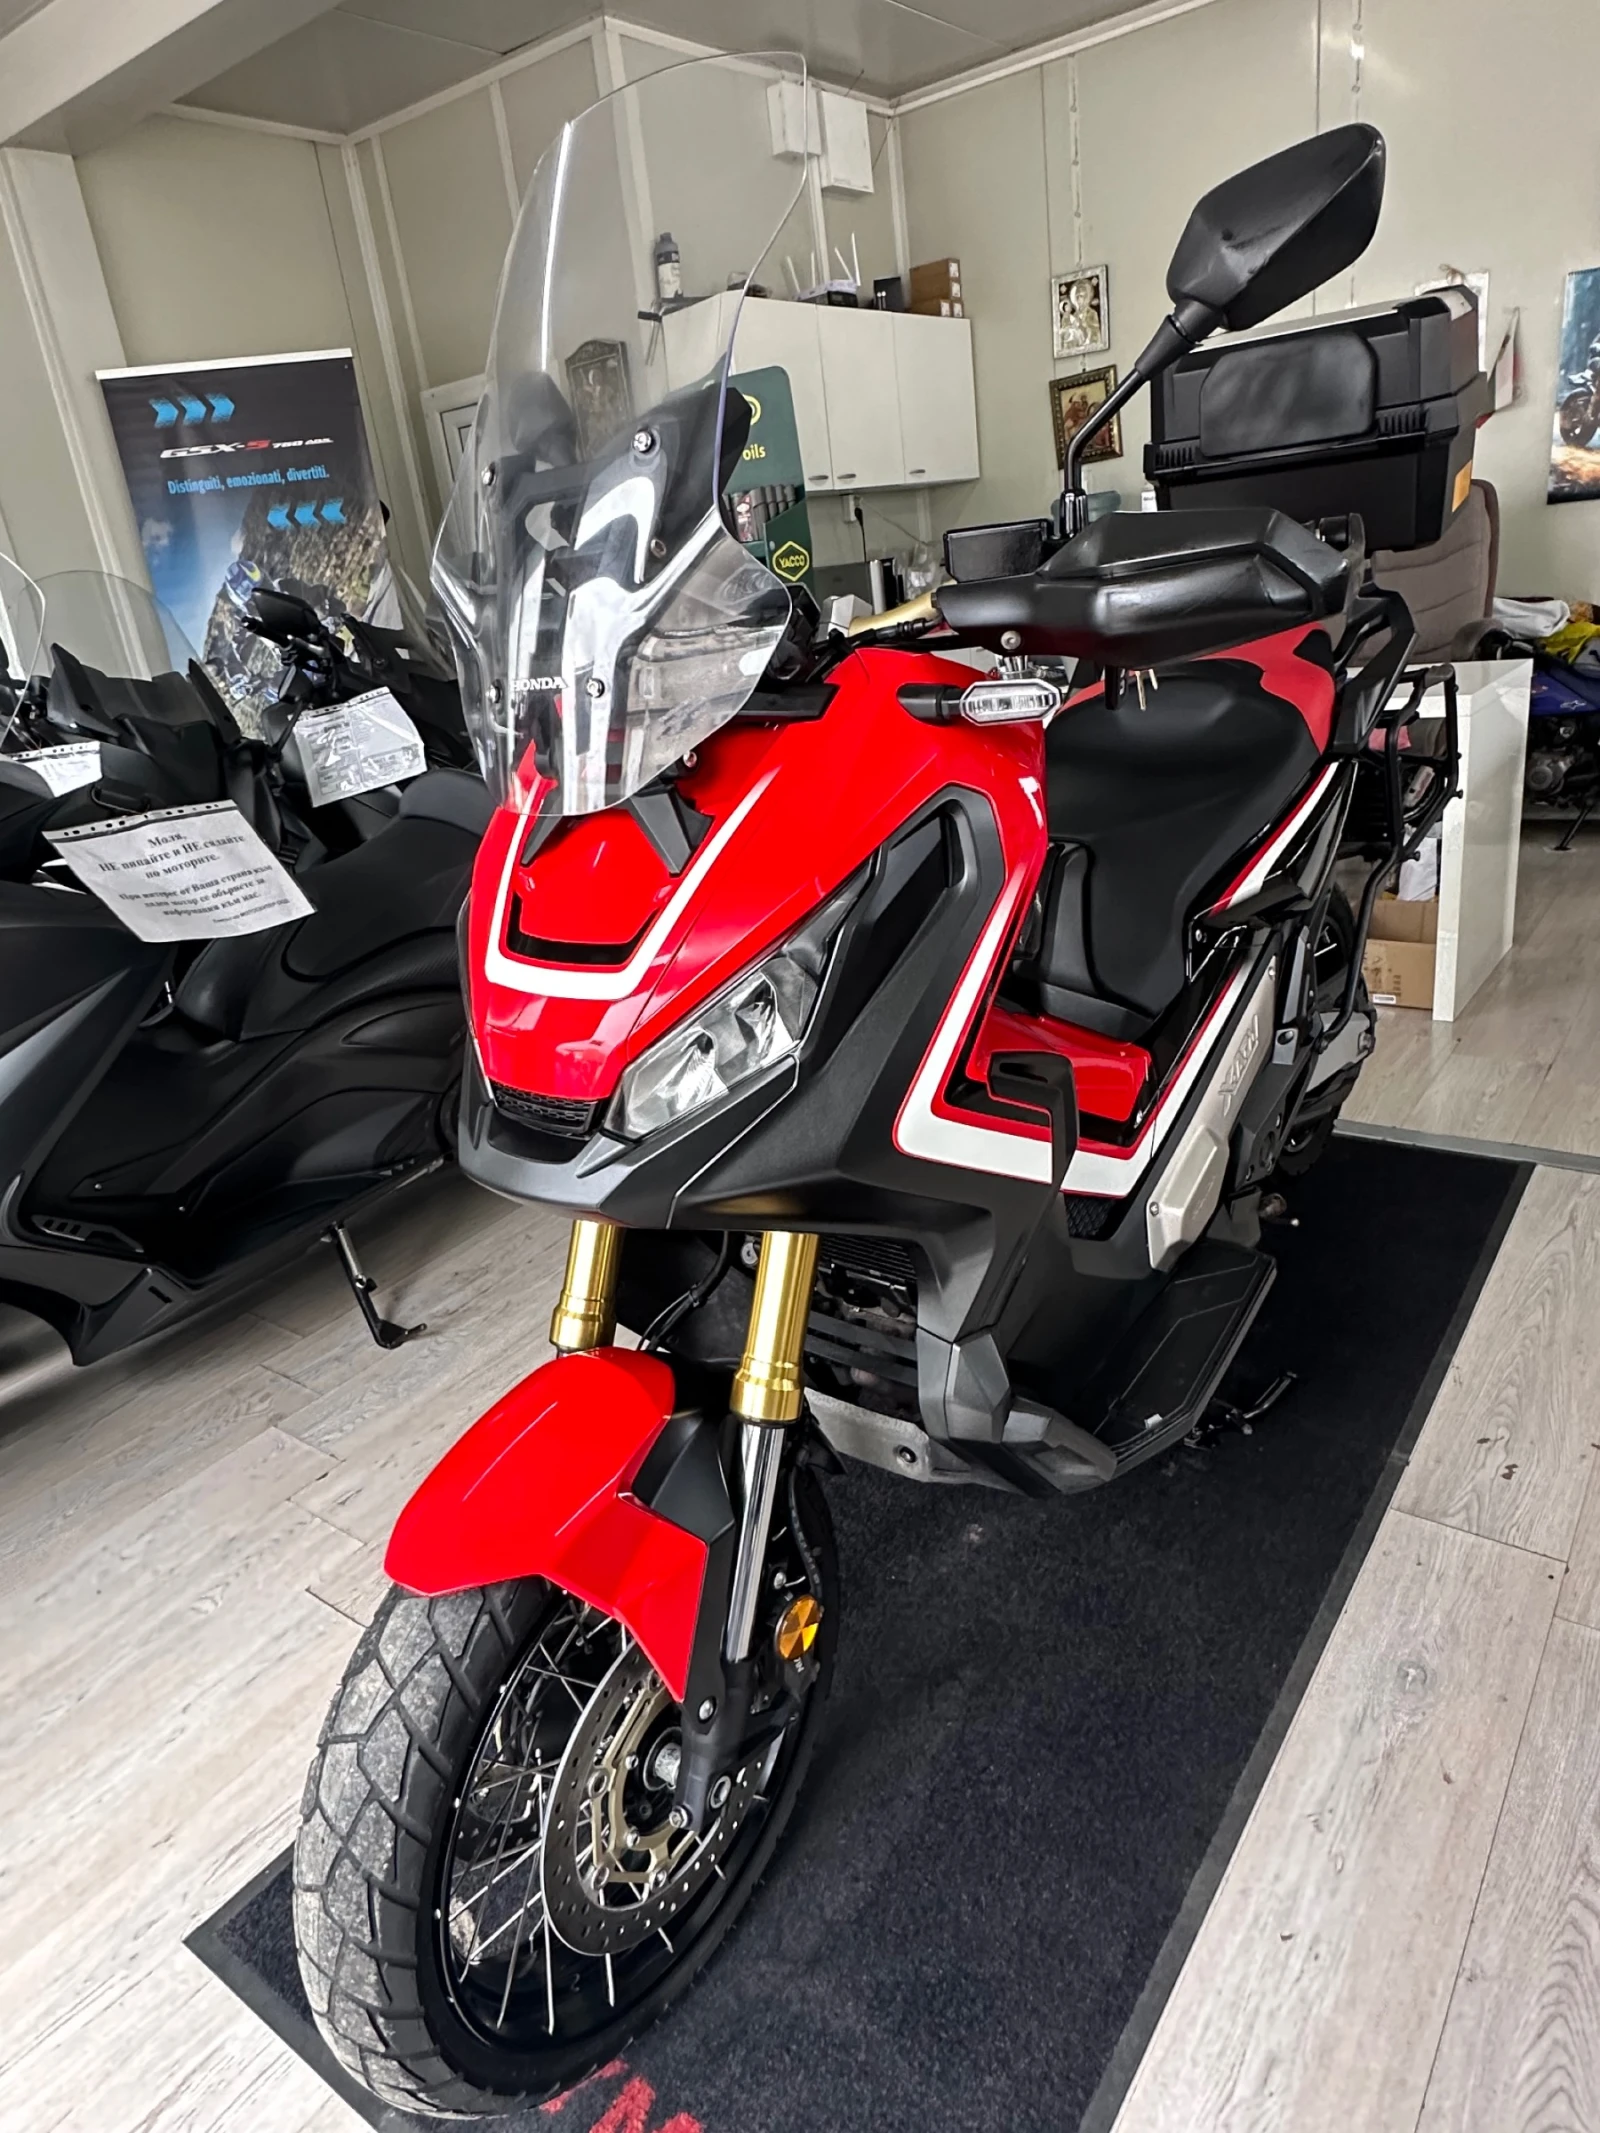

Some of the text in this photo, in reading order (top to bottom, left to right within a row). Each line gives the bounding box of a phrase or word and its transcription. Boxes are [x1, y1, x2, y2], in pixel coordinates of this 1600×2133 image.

[742, 443, 766, 461] oils
[167, 464, 330, 495] Distinguiti, emozionati, divertiti.
[778, 554, 806, 569] YACCO
[509, 676, 568, 691] HONDA
[148, 832, 187, 848] Моля,
[98, 861, 119, 872] НЕ
[121, 852, 171, 870] пипайте
[182, 842, 201, 853] НЕ
[145, 854, 220, 880] по моторите.
